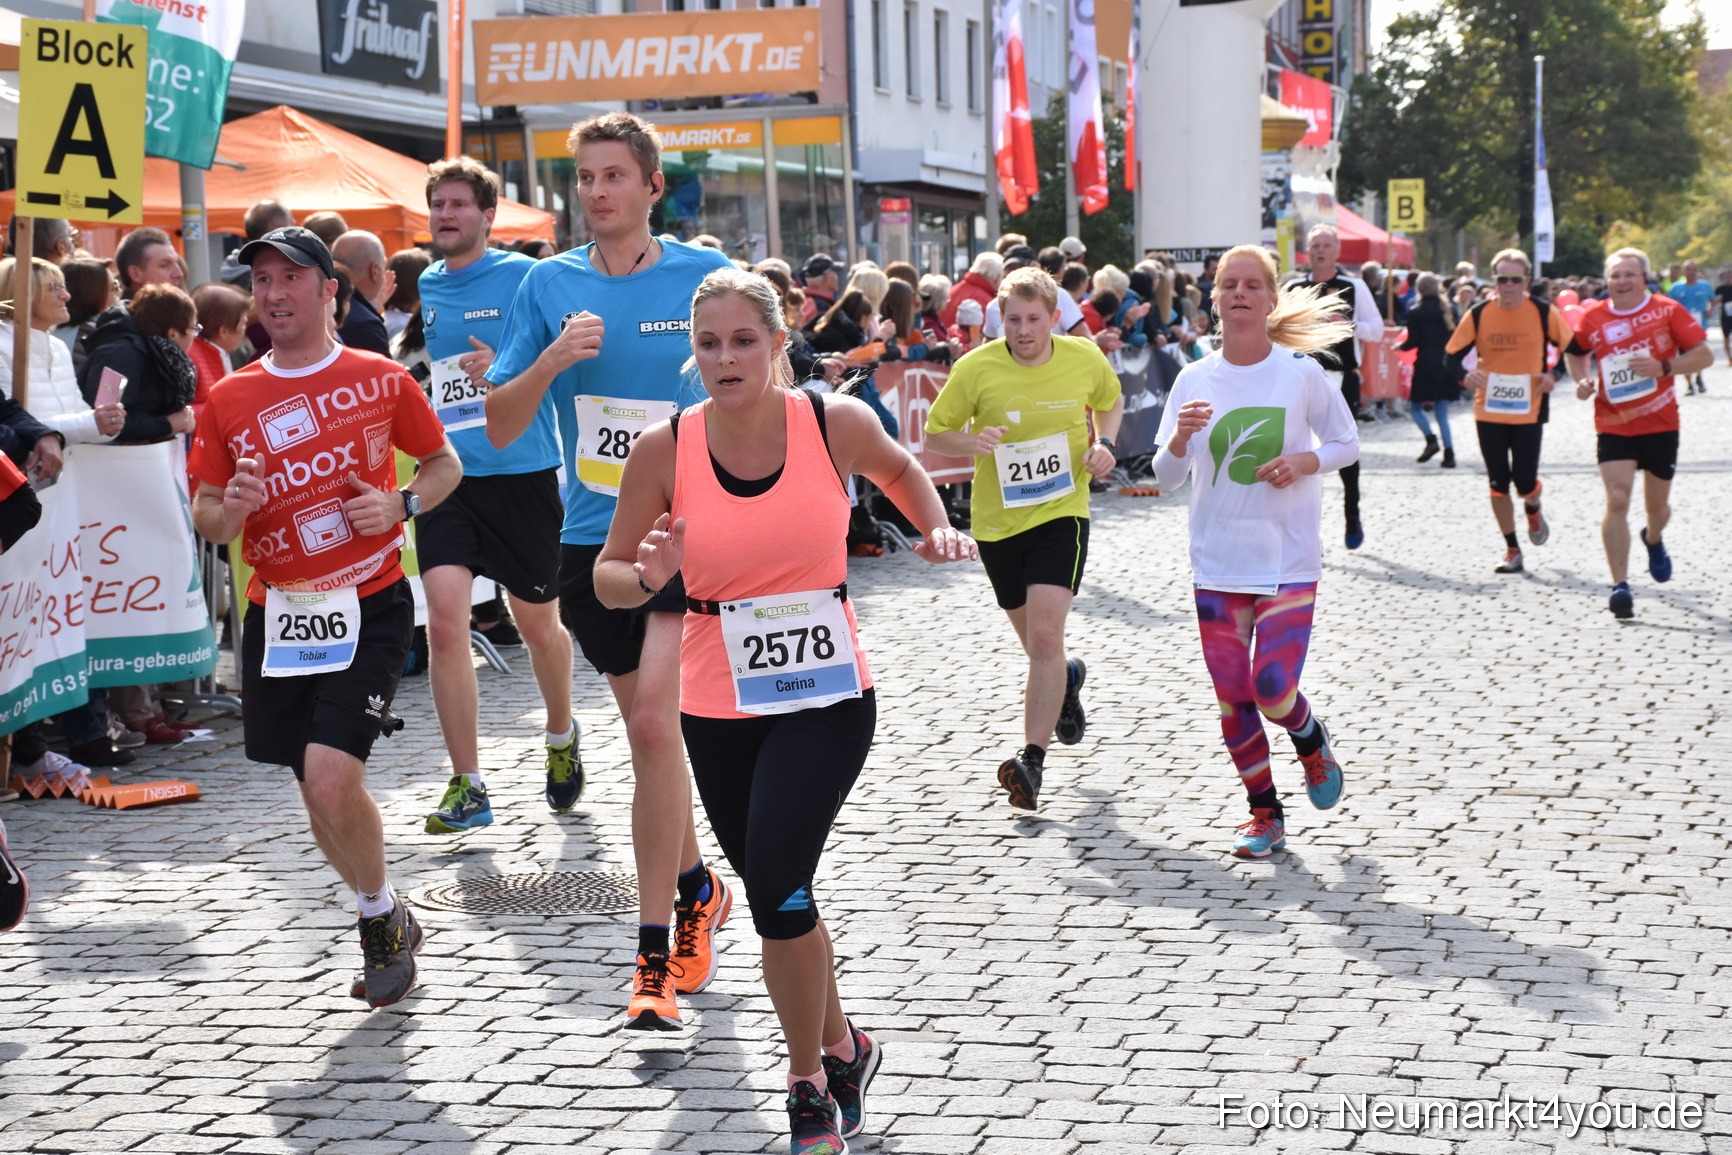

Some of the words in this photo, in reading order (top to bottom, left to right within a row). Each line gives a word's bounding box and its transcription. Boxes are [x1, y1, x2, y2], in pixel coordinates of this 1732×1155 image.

[37, 27, 134, 69] Block
[487, 33, 803, 84] RUNMARKT.DE
[44, 82, 117, 180] A
[1398, 196, 1415, 220] B
[464, 308, 500, 320] BOCK
[639, 319, 692, 334] BOCK
[1492, 386, 1525, 399] 2560
[262, 399, 305, 423] raumbox
[327, 408, 380, 432] schenken
[458, 407, 479, 416] Thore
[611, 407, 647, 418] BOCK
[597, 427, 643, 459] 28
[1008, 454, 1060, 482] 2146
[269, 488, 309, 513] wohnen
[317, 470, 361, 493] outdor
[1020, 481, 1056, 495] Alexander
[297, 503, 340, 524] raumbox
[294, 594, 327, 604] BOCK
[766, 603, 810, 618] BOCK
[277, 611, 347, 641] 2506
[298, 650, 327, 661] Tobias
[743, 624, 836, 670] 2578
[775, 677, 816, 693] Carina
[150, 784, 187, 800] DESIGN
